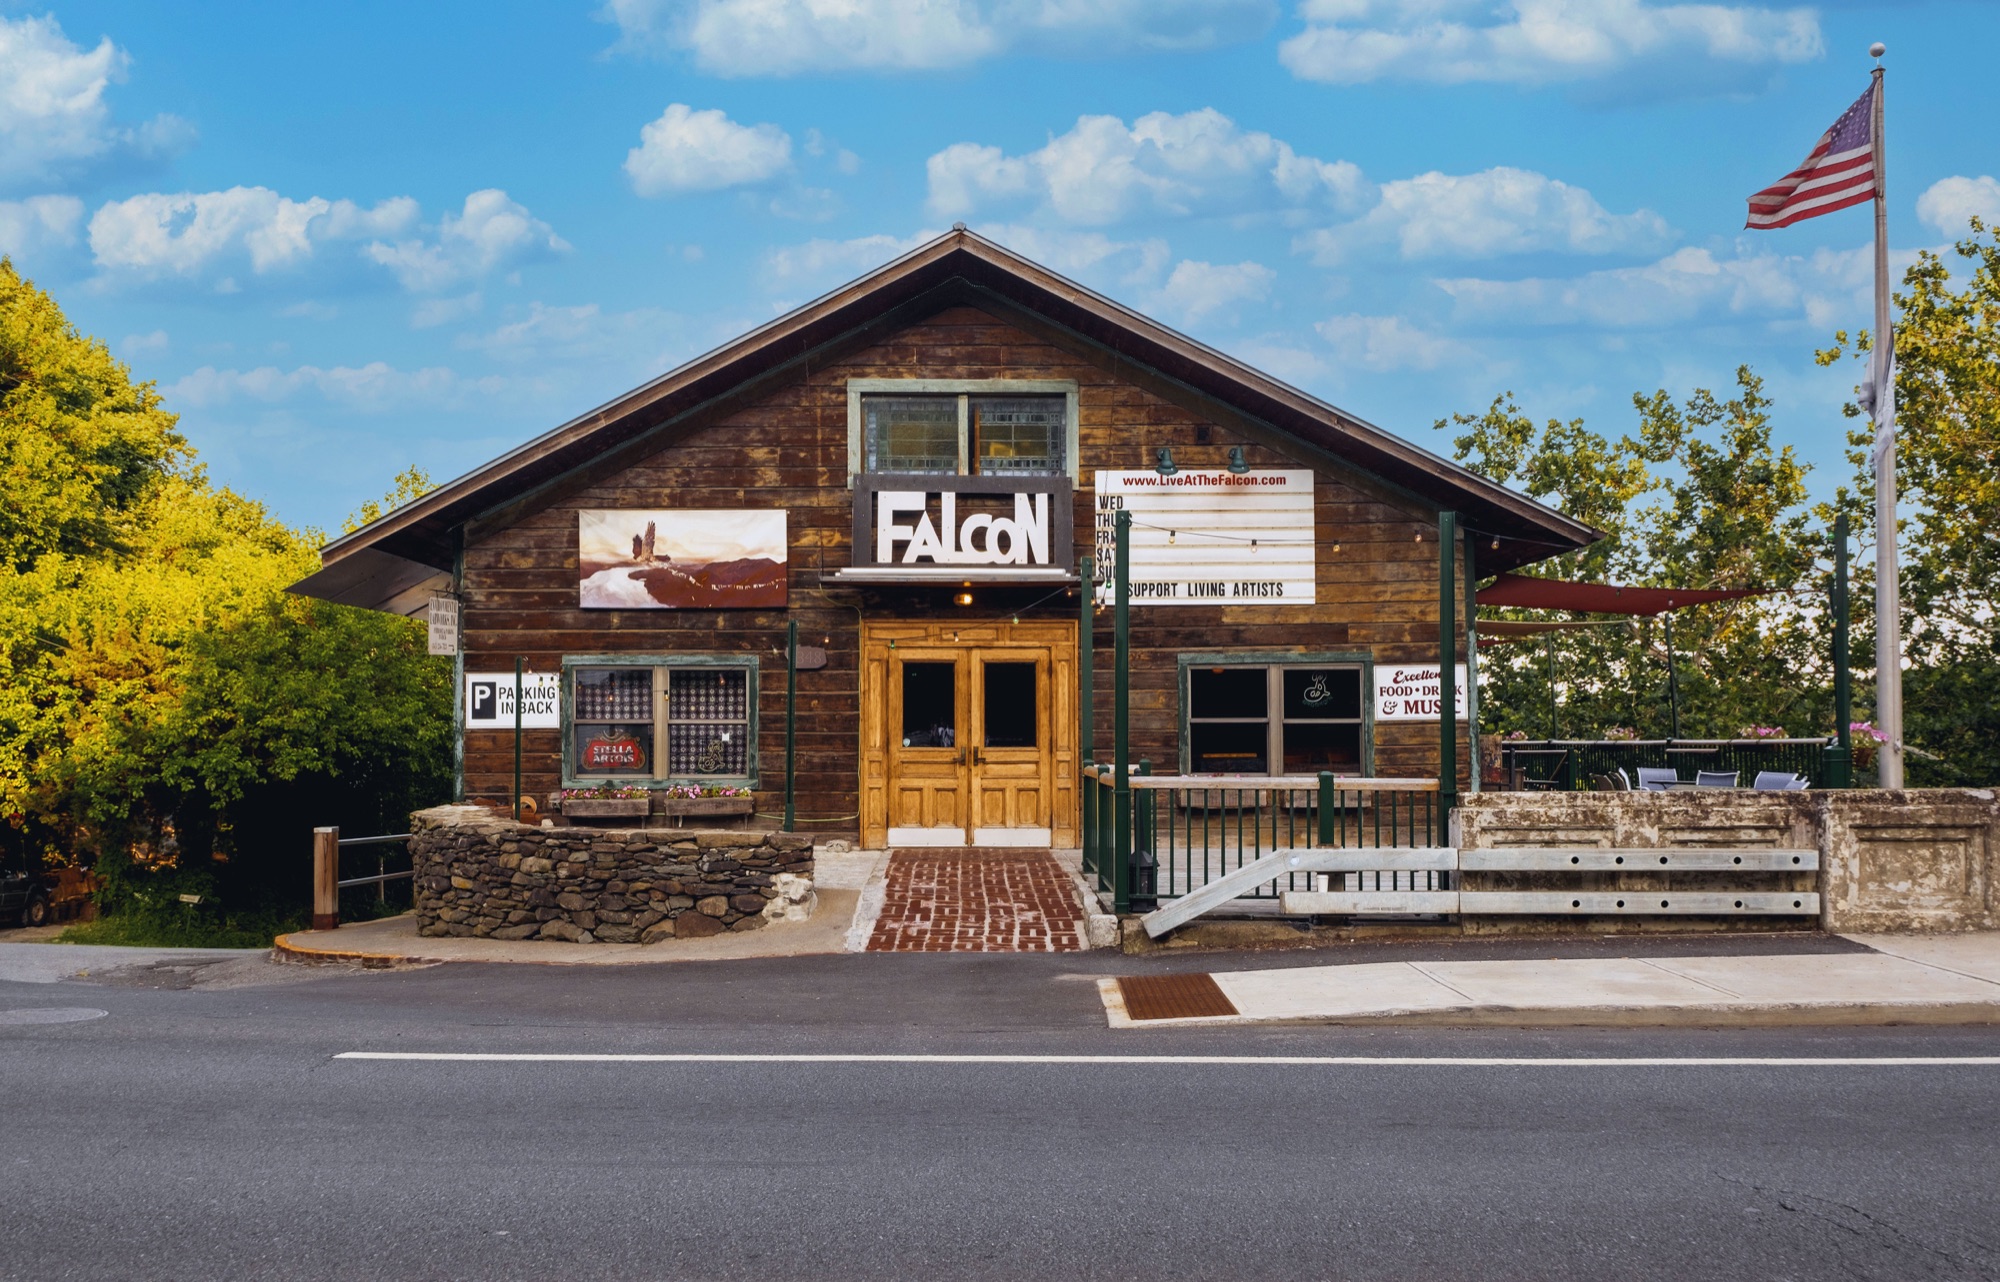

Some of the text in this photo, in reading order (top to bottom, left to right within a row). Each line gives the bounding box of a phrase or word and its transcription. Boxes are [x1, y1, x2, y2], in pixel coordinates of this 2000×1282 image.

[1123, 474, 1287, 486] www.LiveAtTheFalcon.com
[1099, 495, 1124, 510] WED
[1128, 582, 1284, 598] SUPPORT LIVING ARTISTS
[1393, 669, 1442, 684] Excellen
[474, 685, 491, 710] P
[498, 686, 556, 700] PAKING
[1379, 685, 1462, 697] FOOD DRK
[501, 701, 554, 715] IN BACK
[1382, 699, 1461, 715] & MUSC
[593, 745, 634, 755] STELLA
[593, 754, 634, 764] ARTOIS
